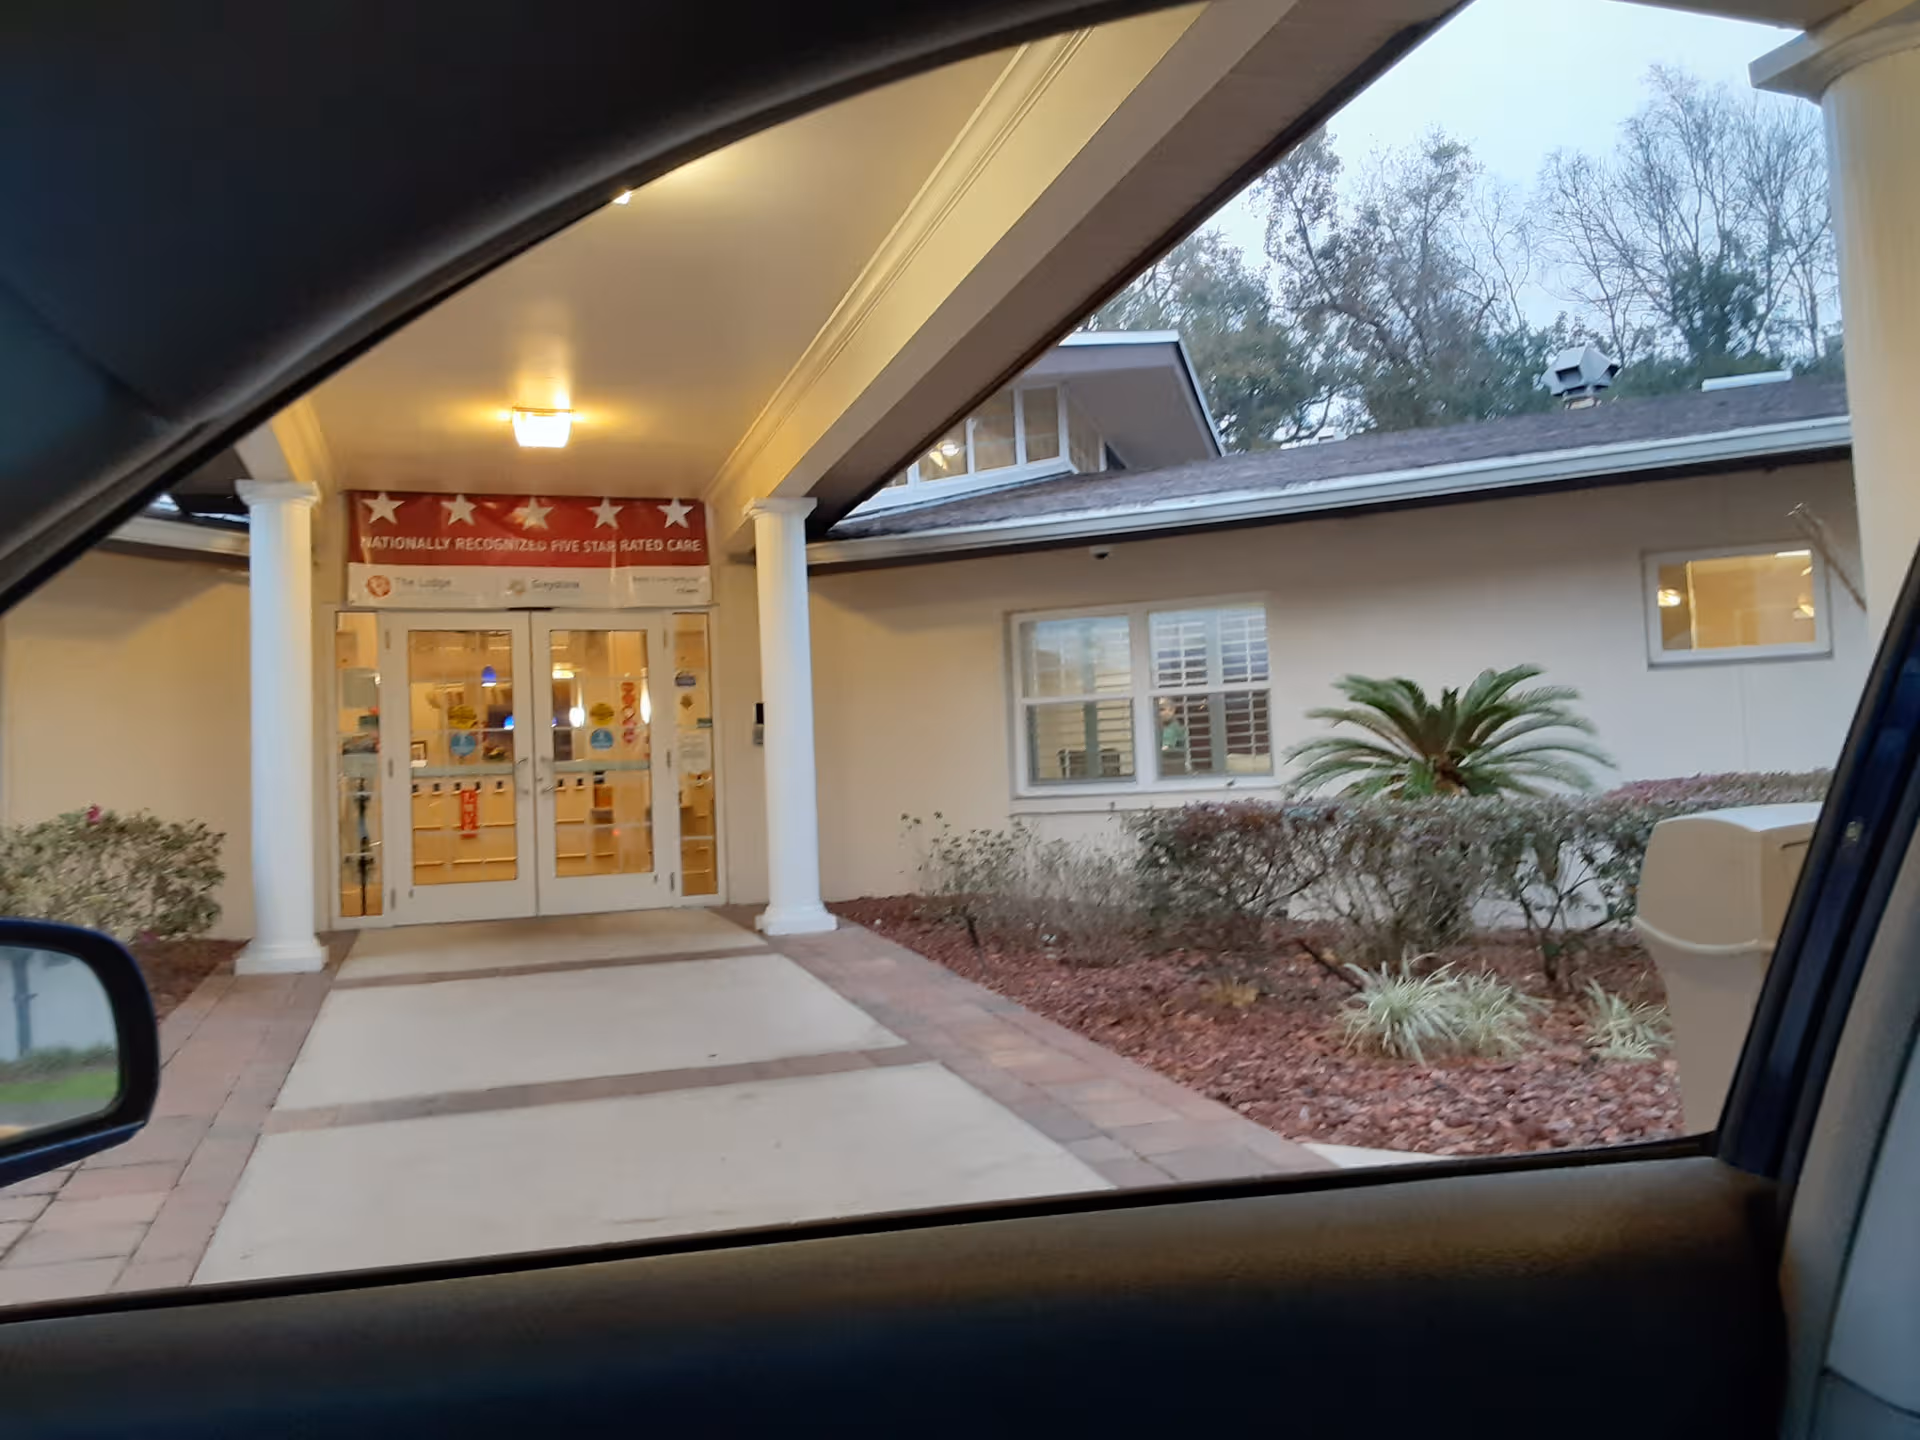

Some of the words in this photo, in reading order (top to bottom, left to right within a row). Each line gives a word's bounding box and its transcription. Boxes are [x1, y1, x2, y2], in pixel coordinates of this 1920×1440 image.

[361, 536, 451, 550] NATIONALLY
[455, 537, 547, 551] RECOGNIZED
[551, 539, 580, 552] FIVE
[583, 539, 616, 552] STAR
[620, 538, 664, 552] RATED
[667, 538, 702, 551] CARE
